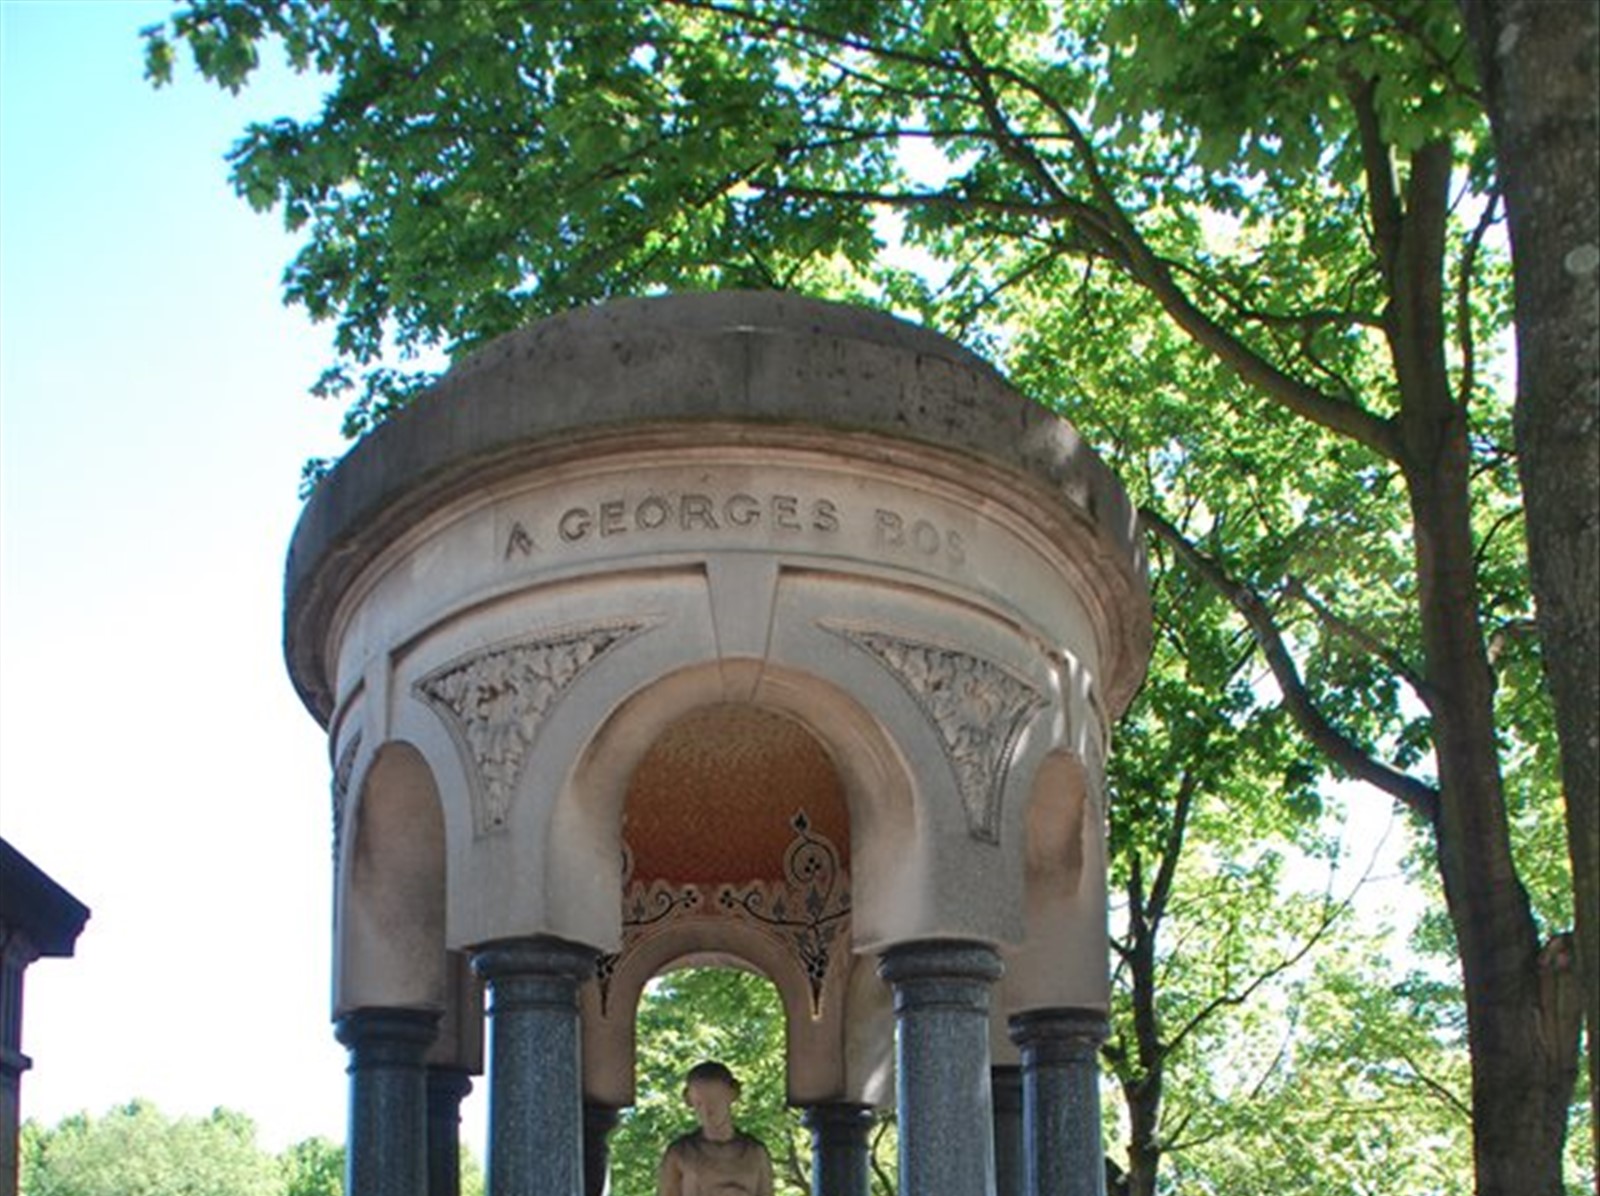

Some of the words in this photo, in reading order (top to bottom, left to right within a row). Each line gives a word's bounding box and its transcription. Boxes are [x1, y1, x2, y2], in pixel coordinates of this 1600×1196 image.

[505, 520, 535, 561] A
[558, 493, 840, 542] GEORGES
[873, 507, 967, 566] BOS
